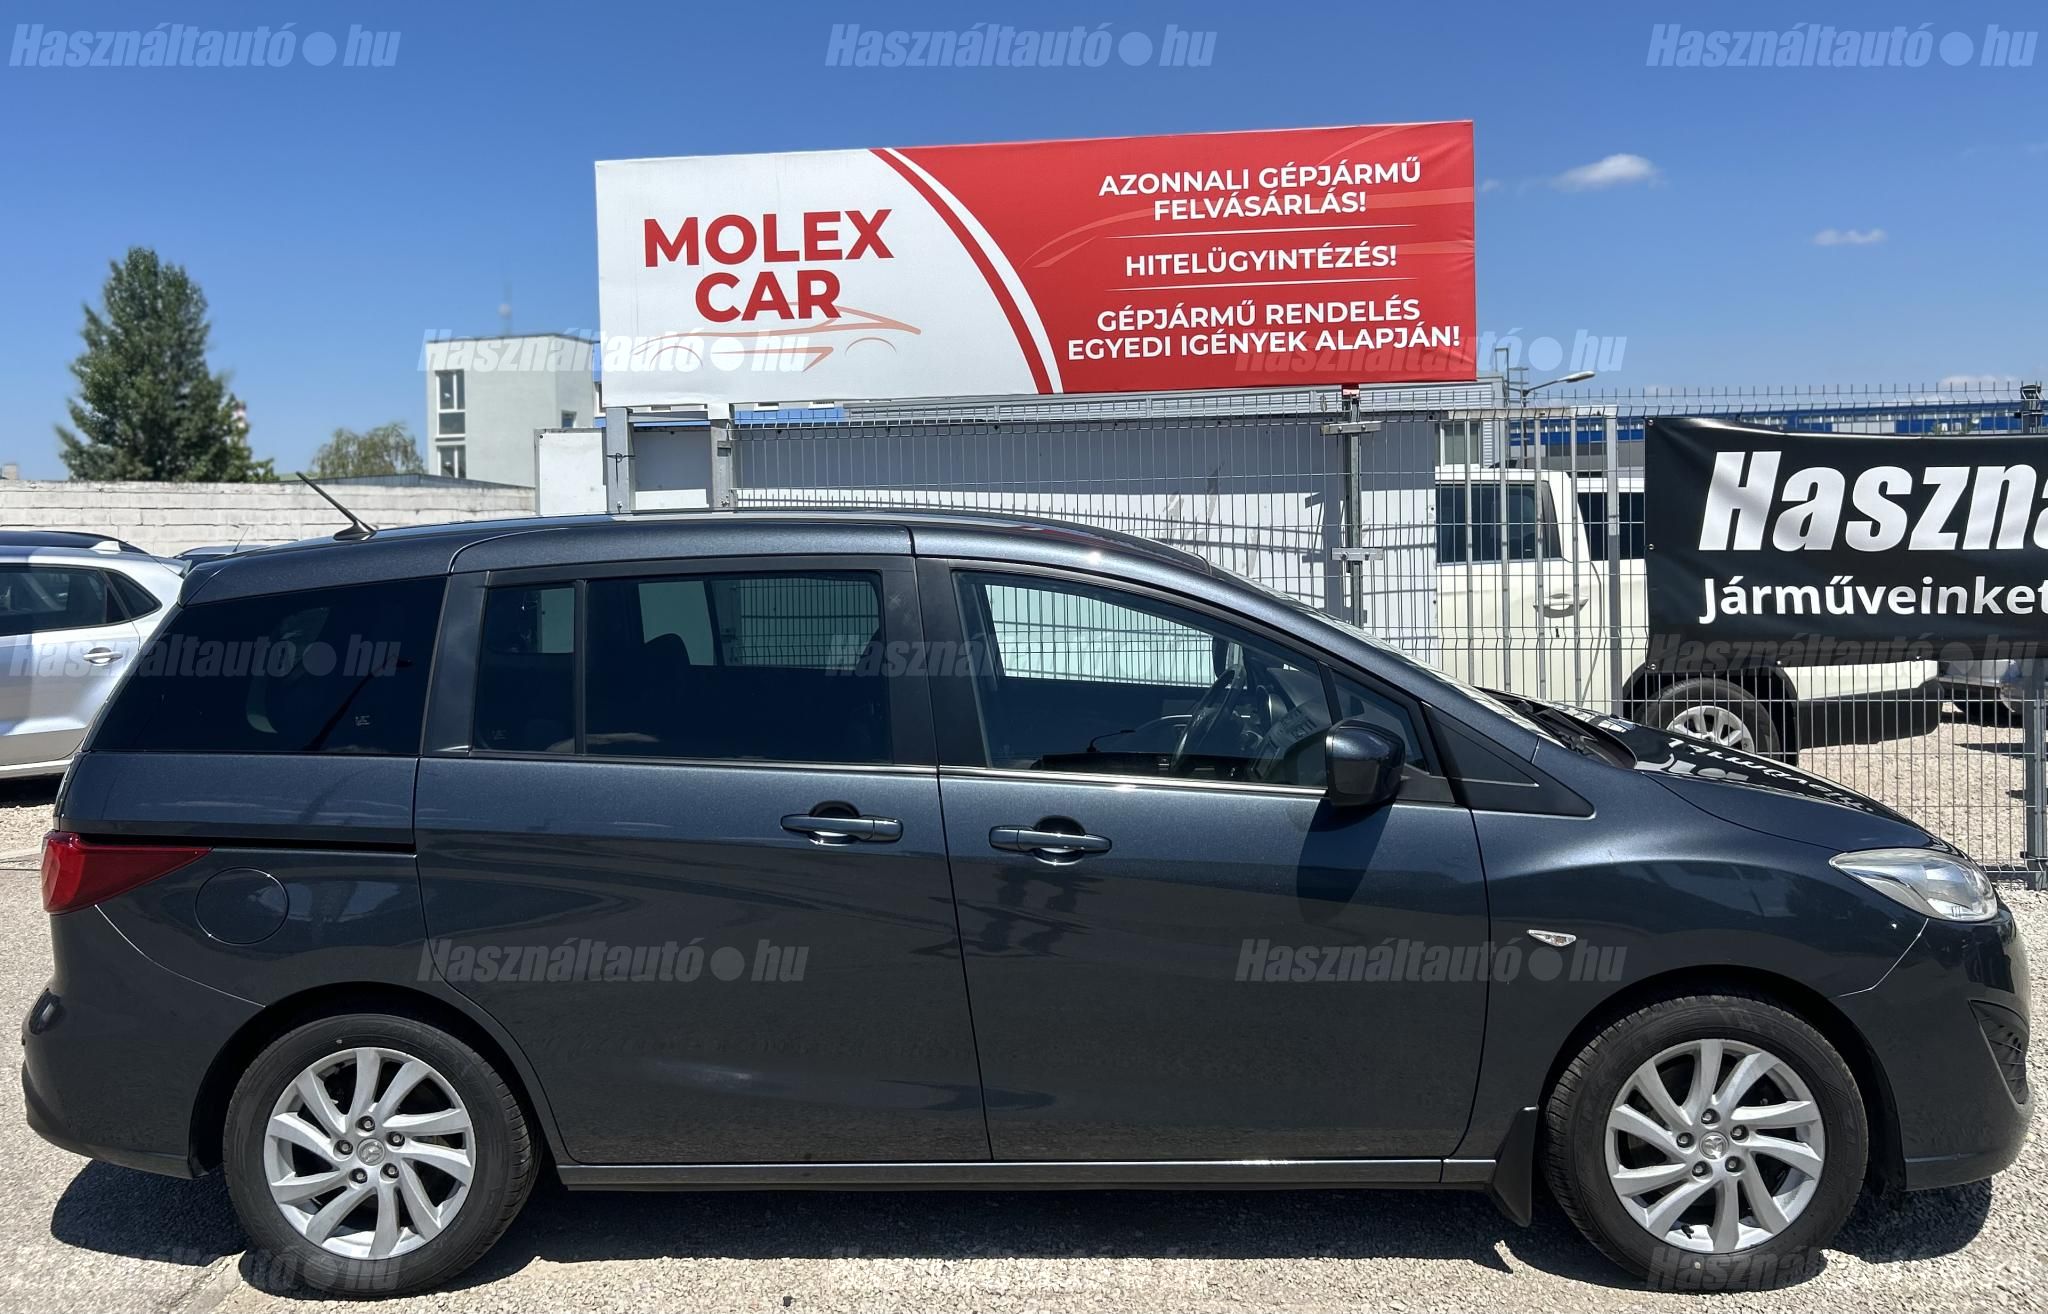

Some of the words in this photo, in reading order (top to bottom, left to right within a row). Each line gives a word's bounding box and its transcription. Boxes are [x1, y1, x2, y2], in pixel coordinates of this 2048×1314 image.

[1099, 168, 1249, 196] AZONNALI
[1258, 156, 1421, 188] GÉPJÁRMŰ
[1154, 189, 1366, 221] FELVÁSÁRLÁS!
[644, 209, 894, 267] MOLEX
[1126, 240, 1397, 277] HITELÜGYINTÉZÉS!
[695, 269, 841, 323] CAR
[1097, 299, 1256, 333] GÉPJÁRMŰ
[1265, 294, 1420, 324] RENDELÉS
[1068, 334, 1172, 361] EGYEDI
[1181, 327, 1307, 356] IGÉNYEK
[1315, 321, 1461, 351] ALAPJÁN!
